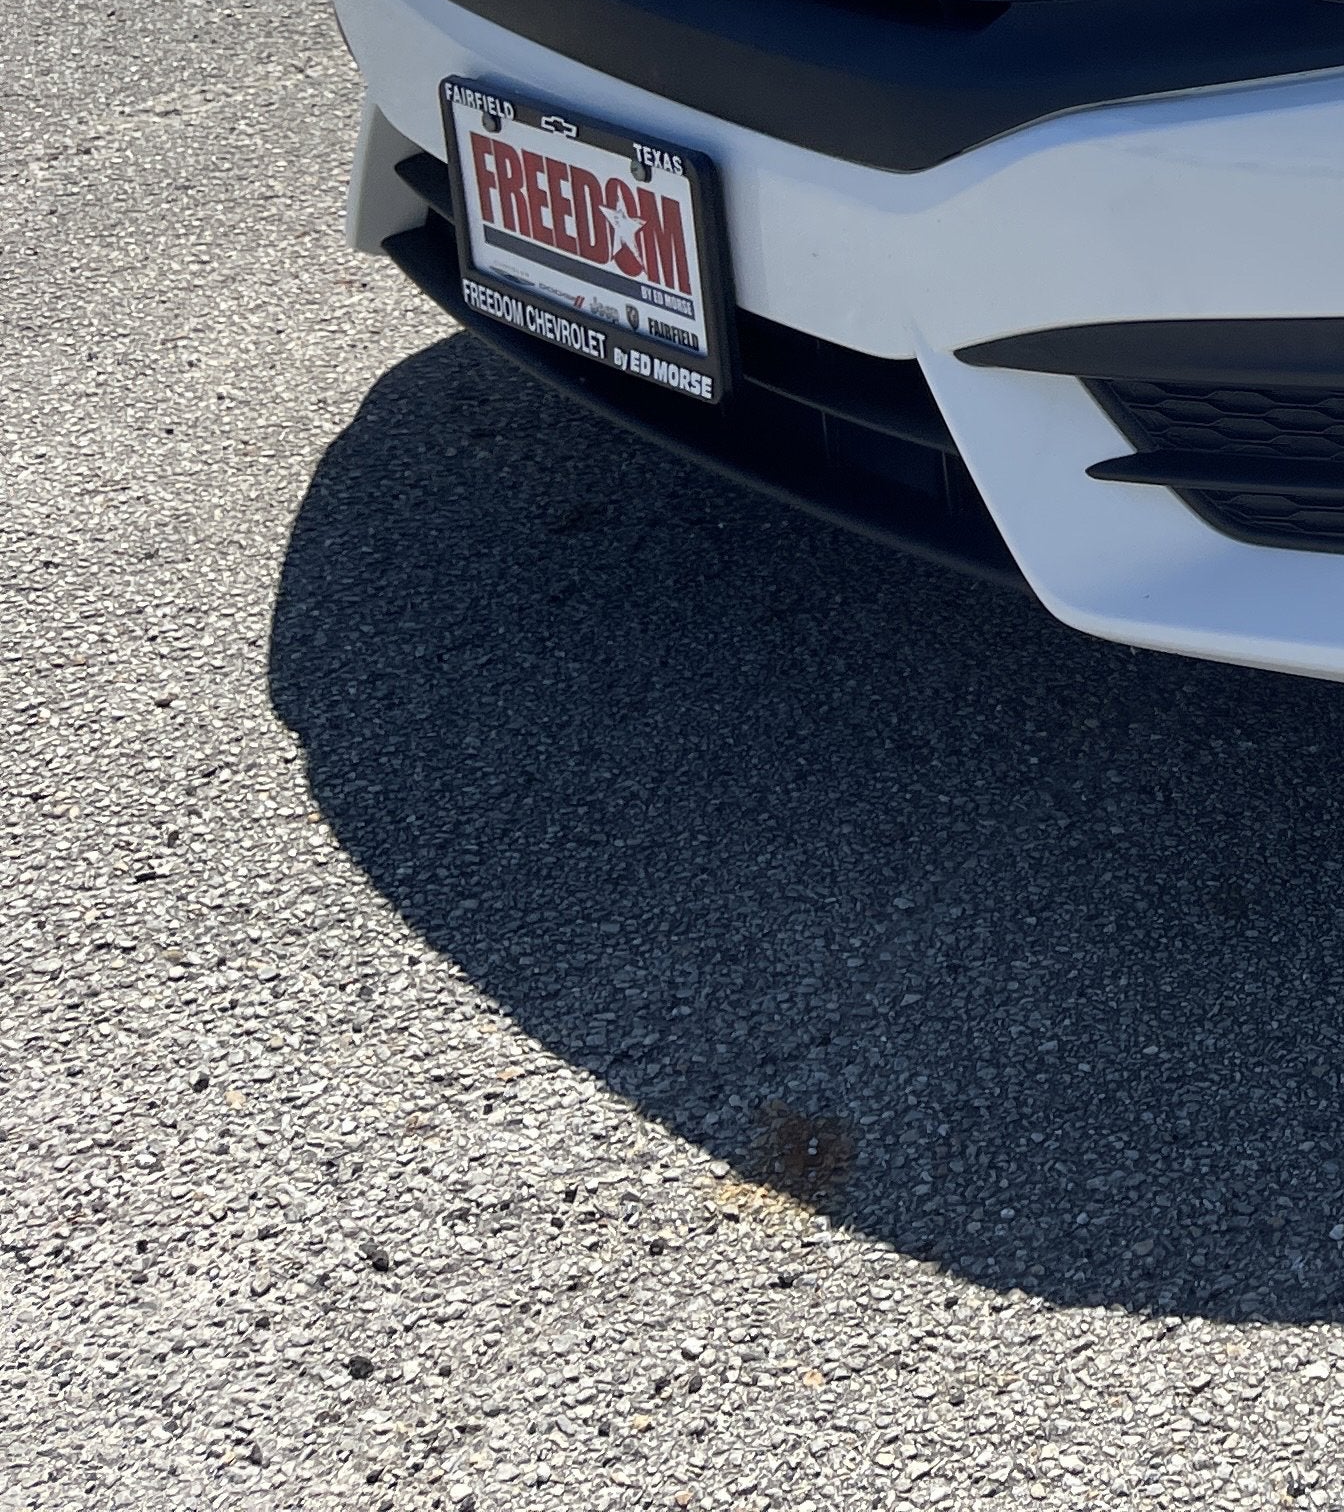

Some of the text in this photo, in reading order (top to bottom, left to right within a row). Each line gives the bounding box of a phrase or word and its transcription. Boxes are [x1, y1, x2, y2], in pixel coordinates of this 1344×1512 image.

[444, 82, 515, 120] FAIRFIELD
[632, 143, 683, 174] TEXAS
[470, 133, 691, 295] FREEDOM
[463, 279, 713, 399] FREEDOM CHEVROLET By ED MORSE
